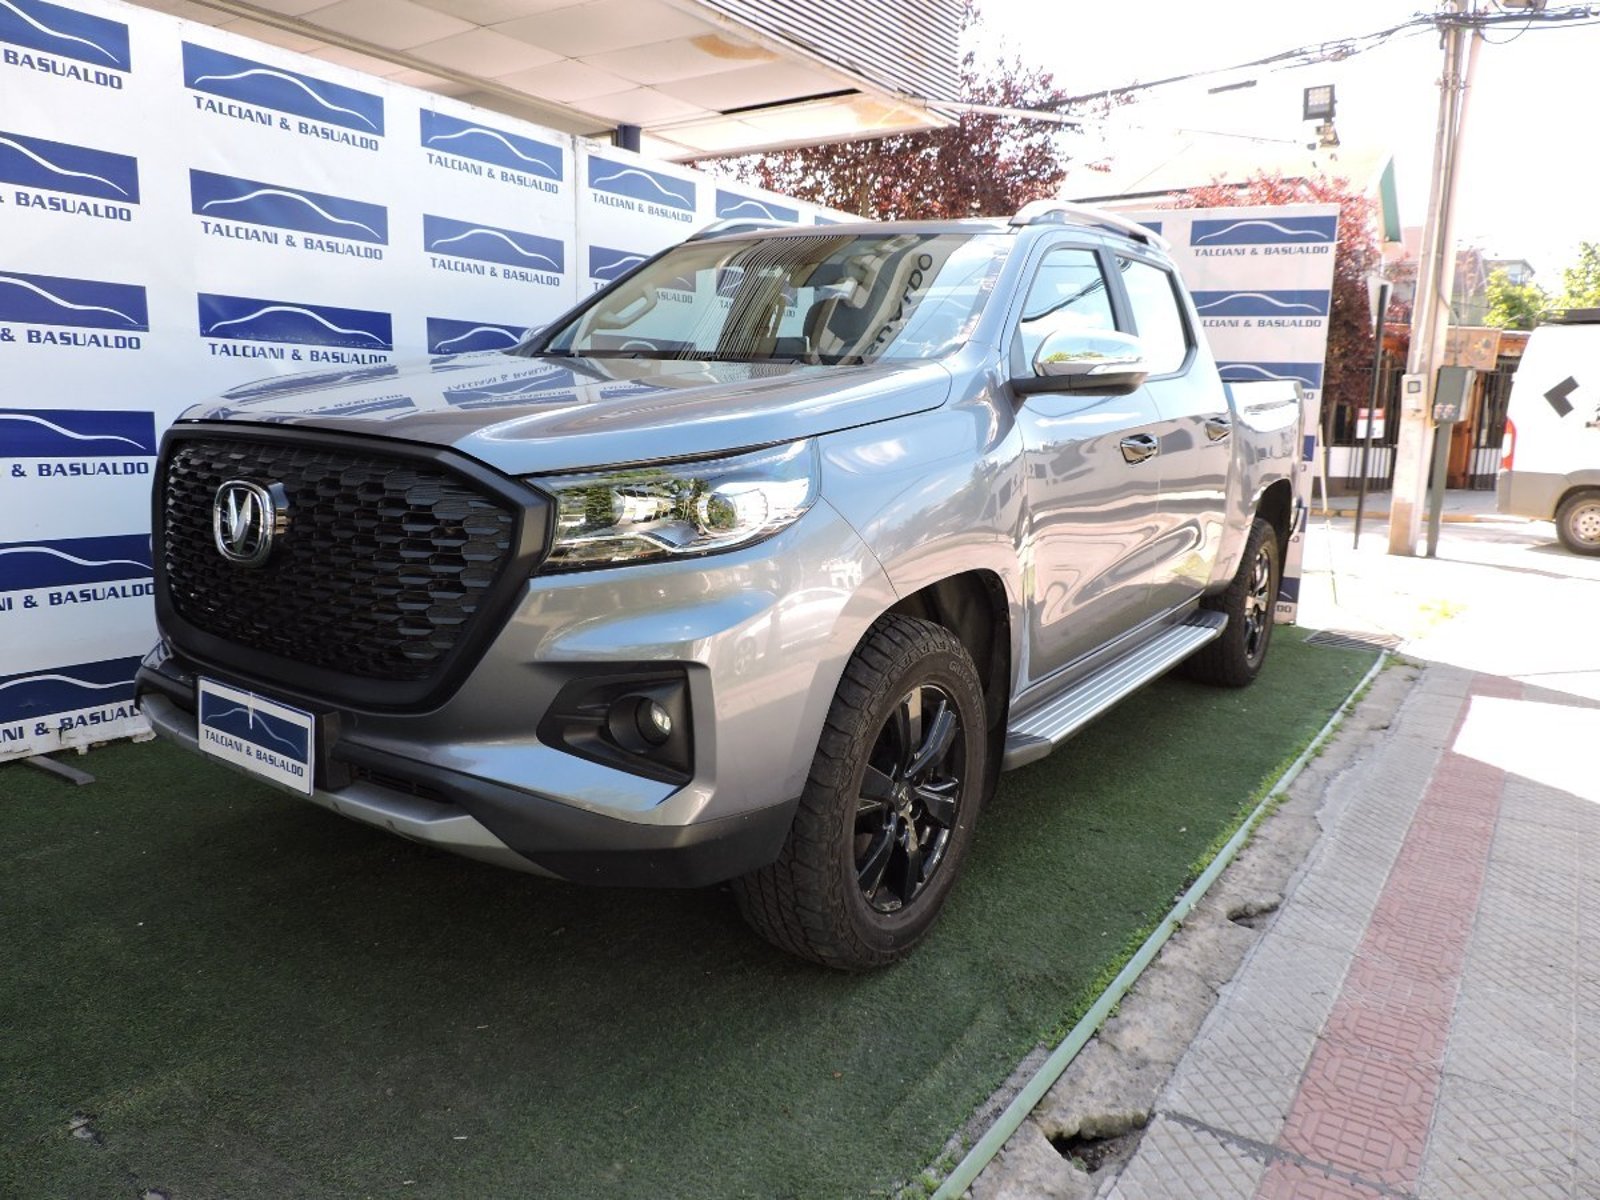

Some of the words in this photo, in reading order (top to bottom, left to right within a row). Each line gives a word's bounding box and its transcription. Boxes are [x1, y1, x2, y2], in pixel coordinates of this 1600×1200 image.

[5, 48, 122, 90] BASUALDO
[194, 95, 273, 127] TALCIANI
[279, 116, 291, 131] &
[298, 121, 379, 152] BASUALDO
[427, 153, 482, 177] TALCIANI
[487, 167, 496, 179] &
[500, 171, 558, 194] BASUALDO
[15, 192, 132, 222] BASUALDO
[592, 192, 634, 210] TALCIANI
[638, 202, 645, 213] &
[647, 204, 693, 224] BASUALDO
[201, 221, 278, 246] TALCIANI
[286, 234, 297, 248] &
[304, 237, 384, 260] BASUALDO
[1195, 248, 1246, 257] TALCIANI
[1251, 247, 1258, 256] &
[1264, 246, 1329, 255] BASUALDO
[431, 256, 485, 276] TALCIANI
[490, 266, 498, 277] &
[502, 268, 560, 287] BASUALDO
[656, 291, 693, 304] ASUALDO
[1202, 319, 1239, 328] LCIANI
[1244, 319, 1251, 327] &
[1258, 319, 1321, 328] BASUALDO
[0, 328, 16, 342] &
[27, 329, 141, 350] BASUALDO
[208, 343, 284, 361] TALCIANI
[291, 348, 303, 361] &
[310, 350, 388, 365] BASUALDO
[11, 463, 27, 477] &
[38, 462, 149, 477] BASUALDO
[23, 595, 38, 609] &
[49, 583, 156, 606] BASUALDO
[34, 721, 50, 736] &
[60, 704, 141, 732] BASUAL
[205, 729, 243, 753] TALCIANI
[246, 745, 254, 757] &
[256, 749, 304, 777] BASUALDO
